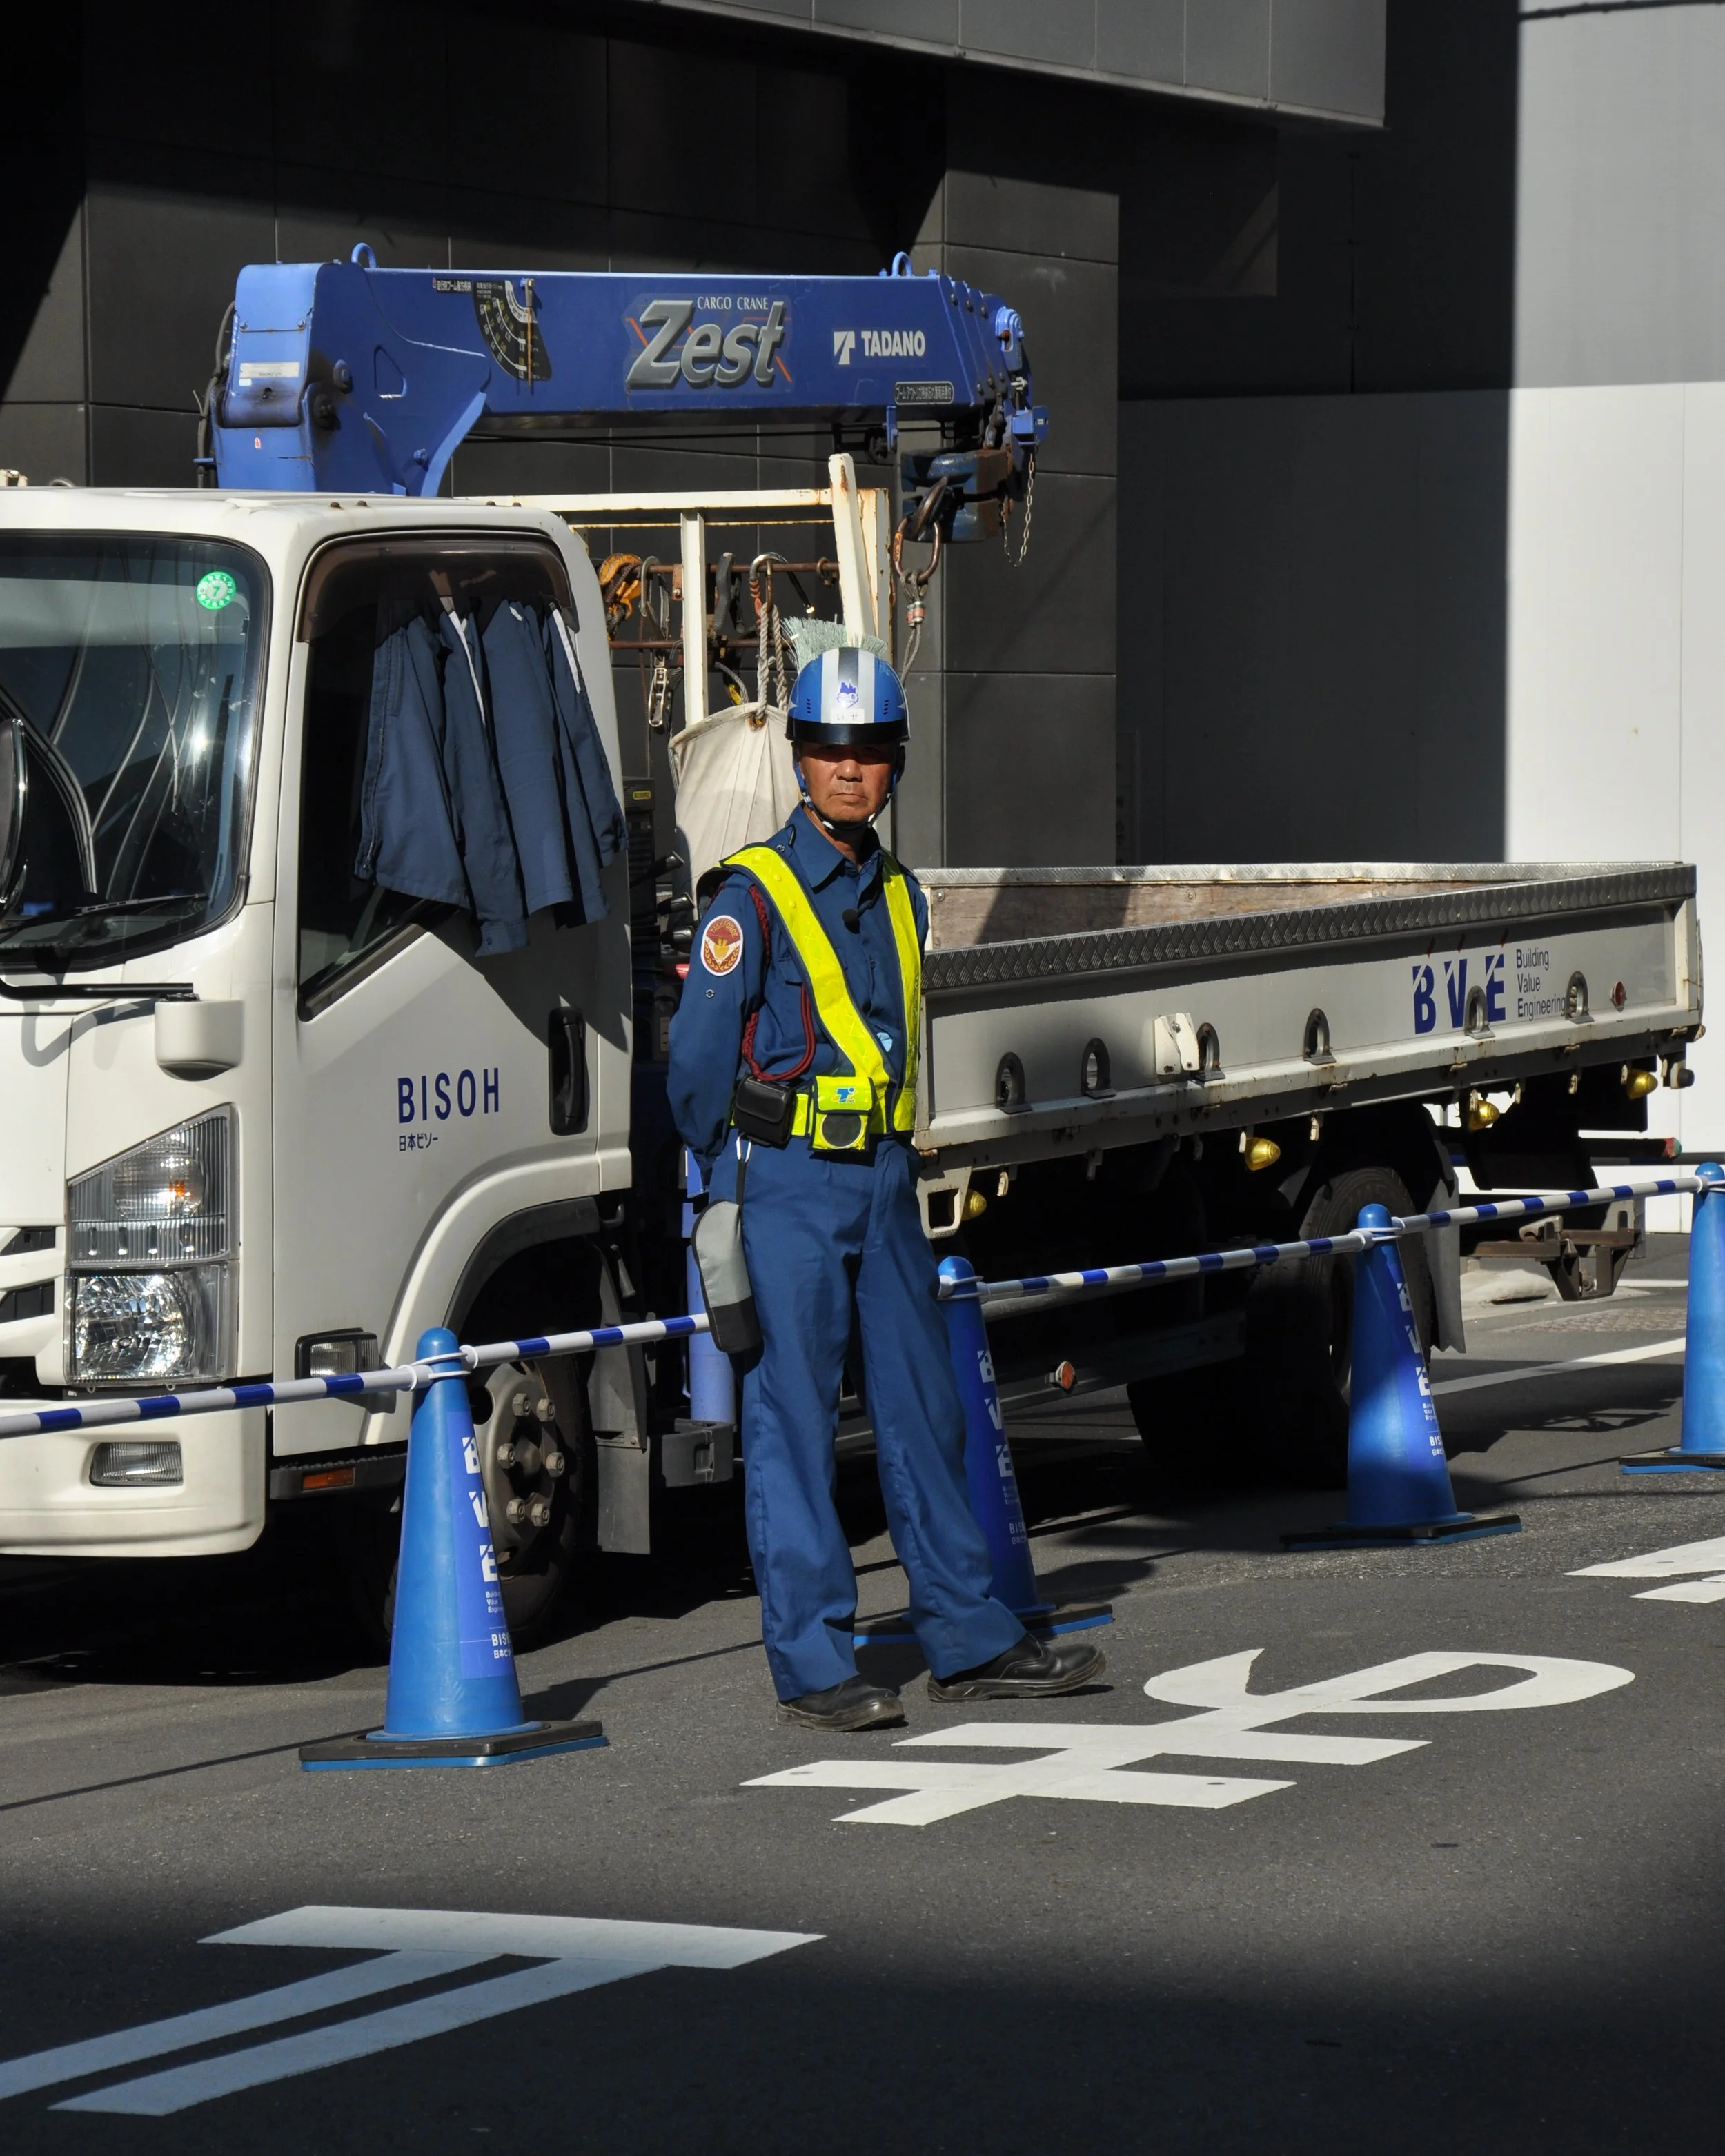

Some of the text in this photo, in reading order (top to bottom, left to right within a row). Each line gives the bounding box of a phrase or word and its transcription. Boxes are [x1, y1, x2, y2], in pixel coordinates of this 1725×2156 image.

[697, 296, 769, 310] CARGO CRANE
[626, 300, 785, 386] Zest
[861, 330, 926, 357] TADANO
[212, 585, 221, 597] 7
[1517, 948, 1549, 970] Building
[1412, 953, 1506, 1034] BVE
[1517, 974, 1541, 993] Value
[1517, 994, 1566, 1021] Engineering
[398, 1067, 499, 1124] BISOH
[399, 1132, 439, 1151] 日本ビソー
